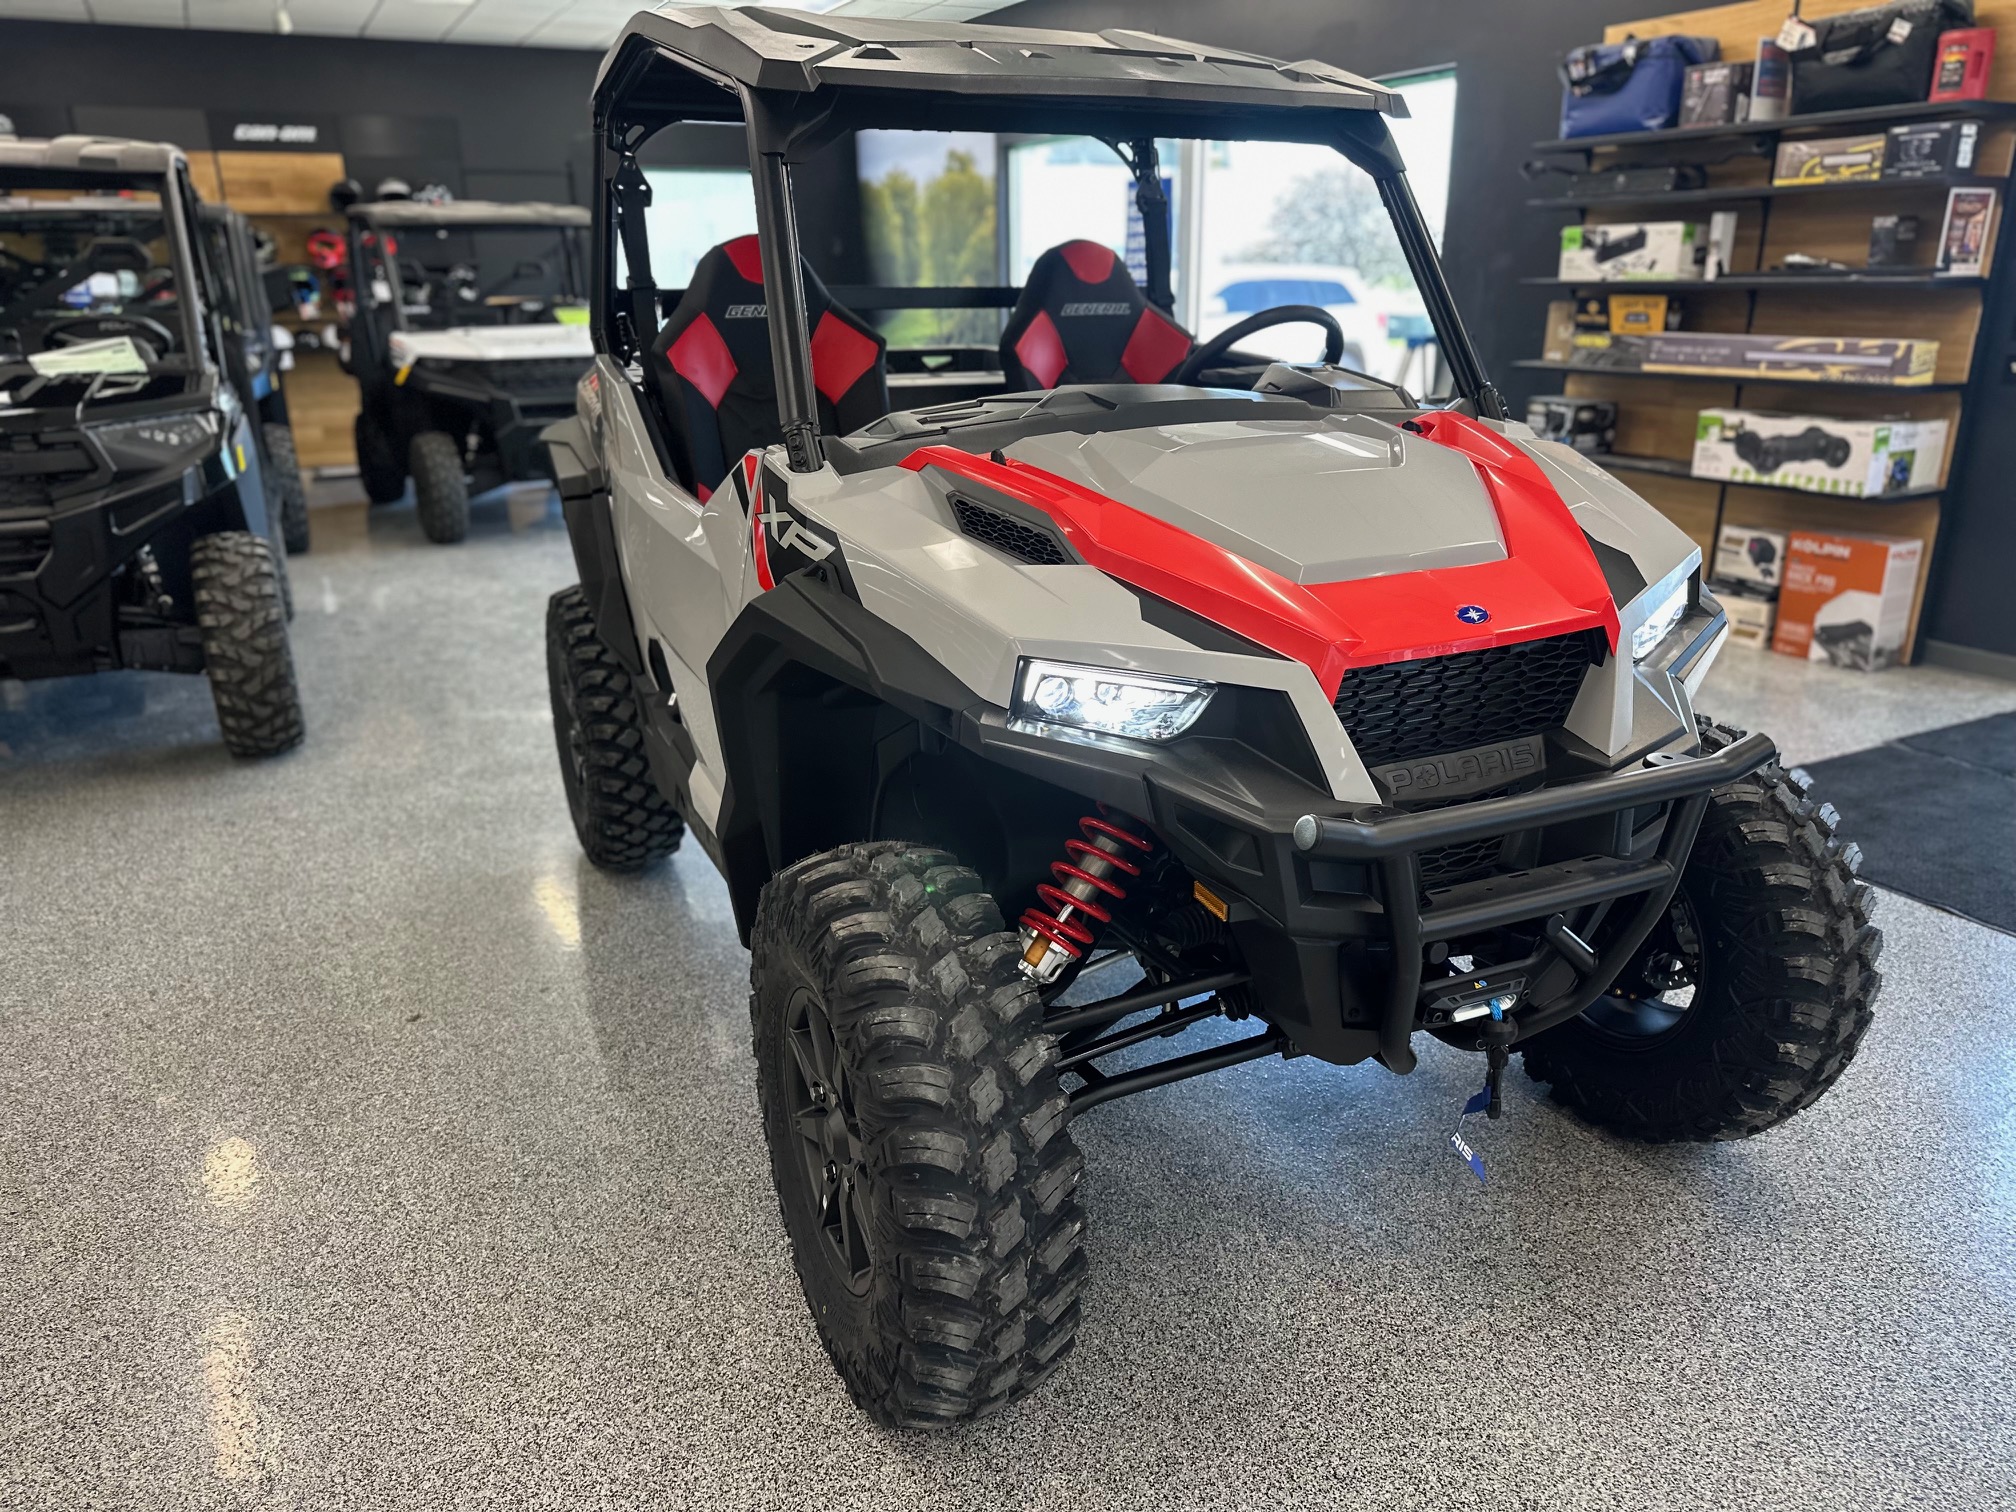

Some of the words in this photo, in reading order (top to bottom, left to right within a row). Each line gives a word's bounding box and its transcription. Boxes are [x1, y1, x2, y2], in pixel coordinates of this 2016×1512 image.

[725, 304, 768, 318] GEN
[1060, 302, 1131, 317] GENERAL
[756, 493, 836, 562] XP
[1791, 538, 1851, 560] KOLPIN
[1385, 743, 1535, 796] POLARIS
[1450, 1131, 1474, 1162] RIS
